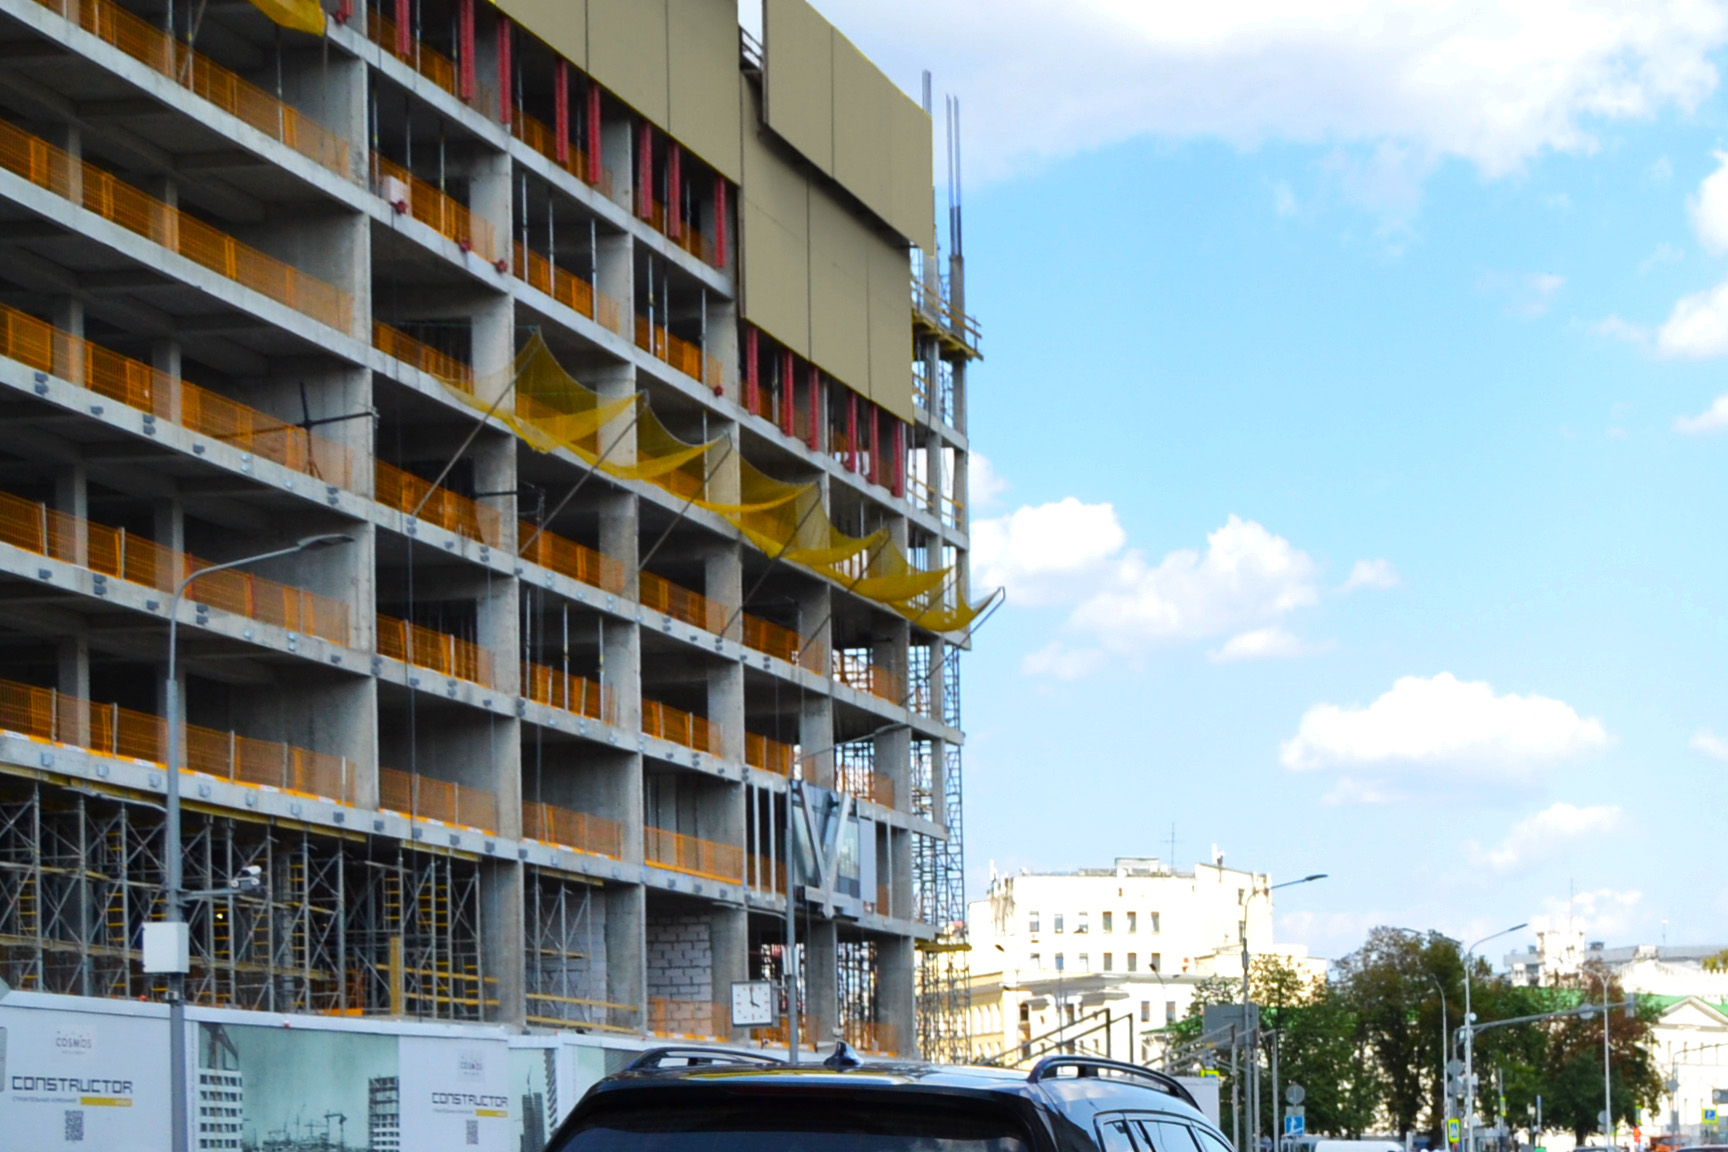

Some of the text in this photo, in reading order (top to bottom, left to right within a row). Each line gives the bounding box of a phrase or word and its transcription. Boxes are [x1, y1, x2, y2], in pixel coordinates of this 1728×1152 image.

[55, 1037, 93, 1049] COSMOS
[12, 1076, 133, 1094] CONSTRUCTOR
[432, 1092, 508, 1107] CONSTRUCTOR
